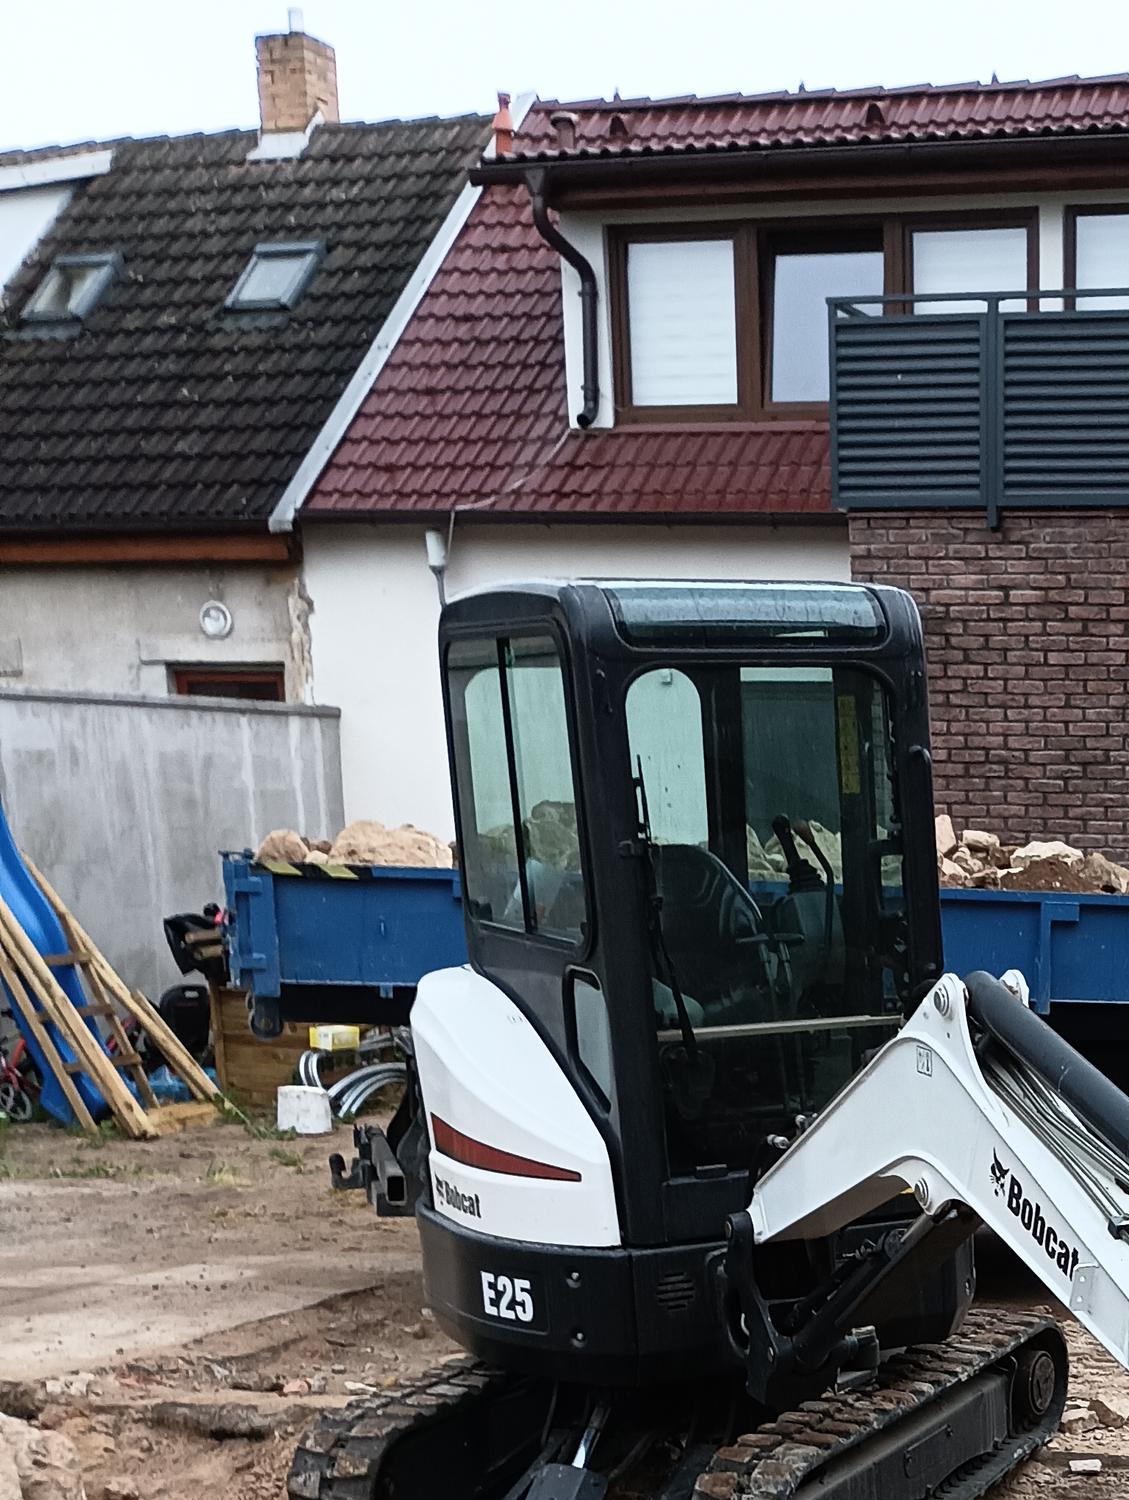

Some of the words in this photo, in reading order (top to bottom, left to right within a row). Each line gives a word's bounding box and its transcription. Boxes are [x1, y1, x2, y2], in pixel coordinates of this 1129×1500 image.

[444, 1180, 482, 1218] Bobcat
[1007, 1174, 1079, 1282] Bobcat
[480, 1271, 534, 1322] E25
